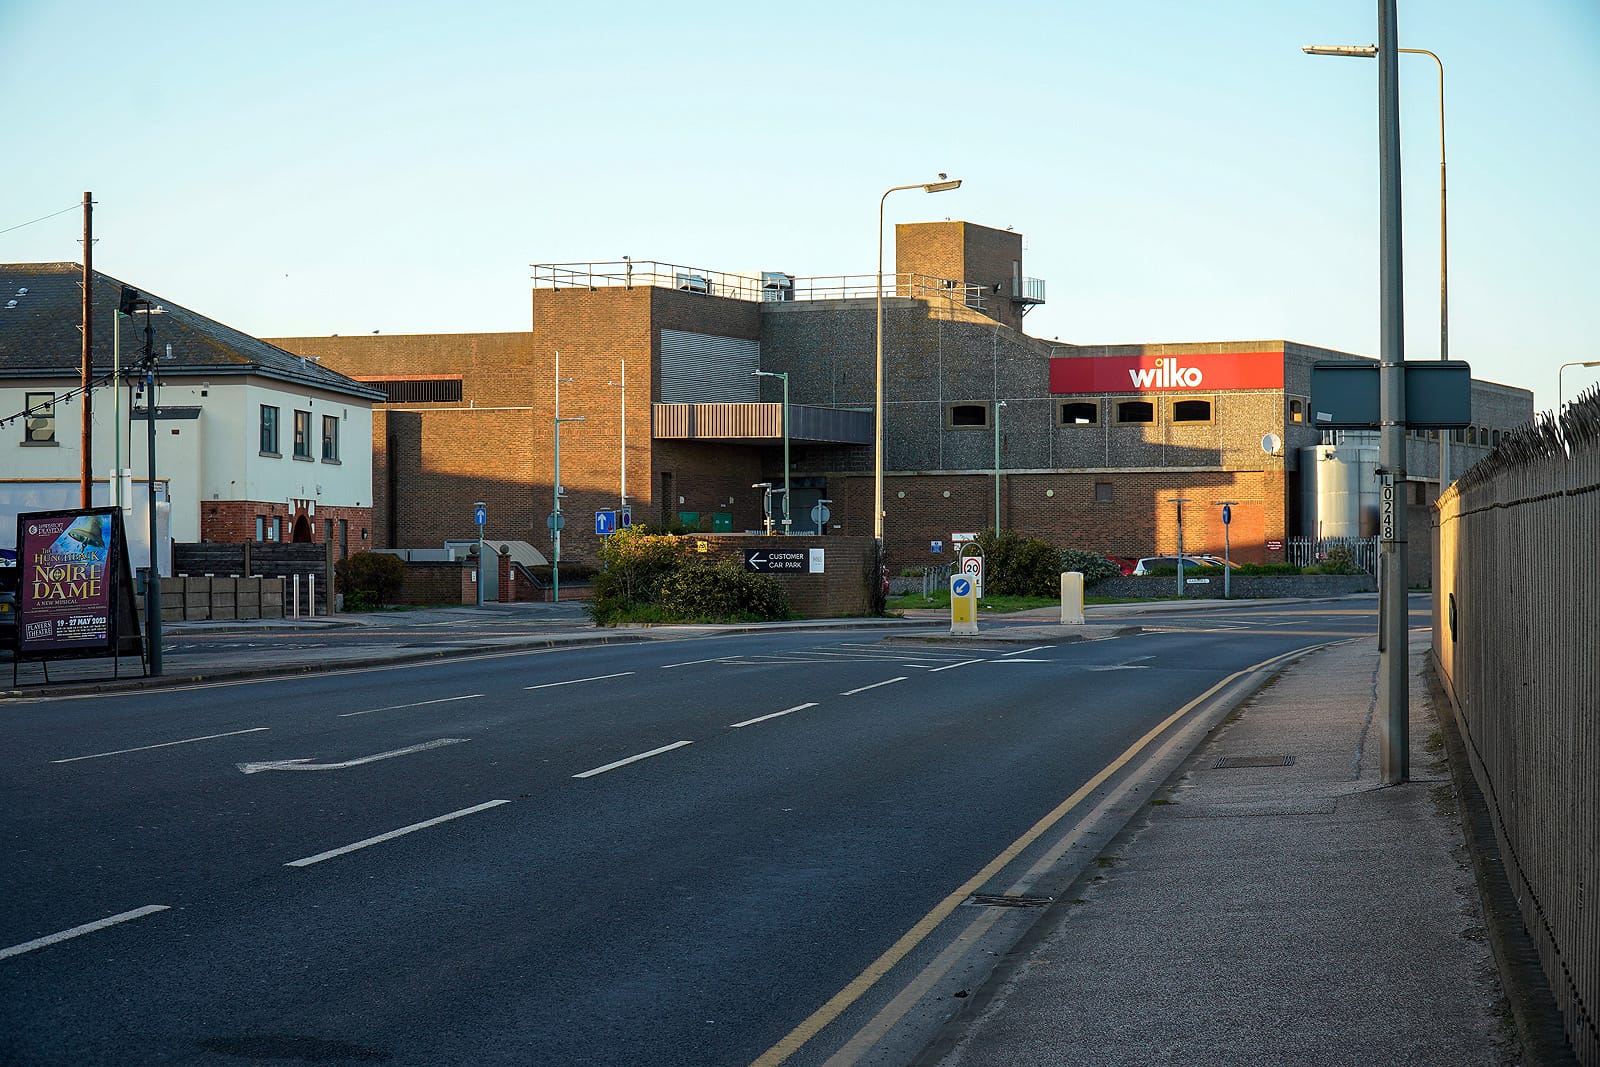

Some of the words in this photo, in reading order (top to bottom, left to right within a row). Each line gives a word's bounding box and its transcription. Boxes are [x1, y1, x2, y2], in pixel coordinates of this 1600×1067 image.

[1129, 358, 1203, 388] wilko
[33, 551, 100, 565] HUNCHBACK
[784, 561, 802, 569] PARK
[966, 564, 979, 573] 20
[32, 562, 101, 583] NOTRE
[31, 580, 101, 600] DAME
[27, 621, 52, 631] PLAYERS
[69, 618, 77, 626] 27
[77, 618, 92, 626] MAY
[92, 616, 107, 625] 2023
[28, 627, 52, 638] THEATRE
